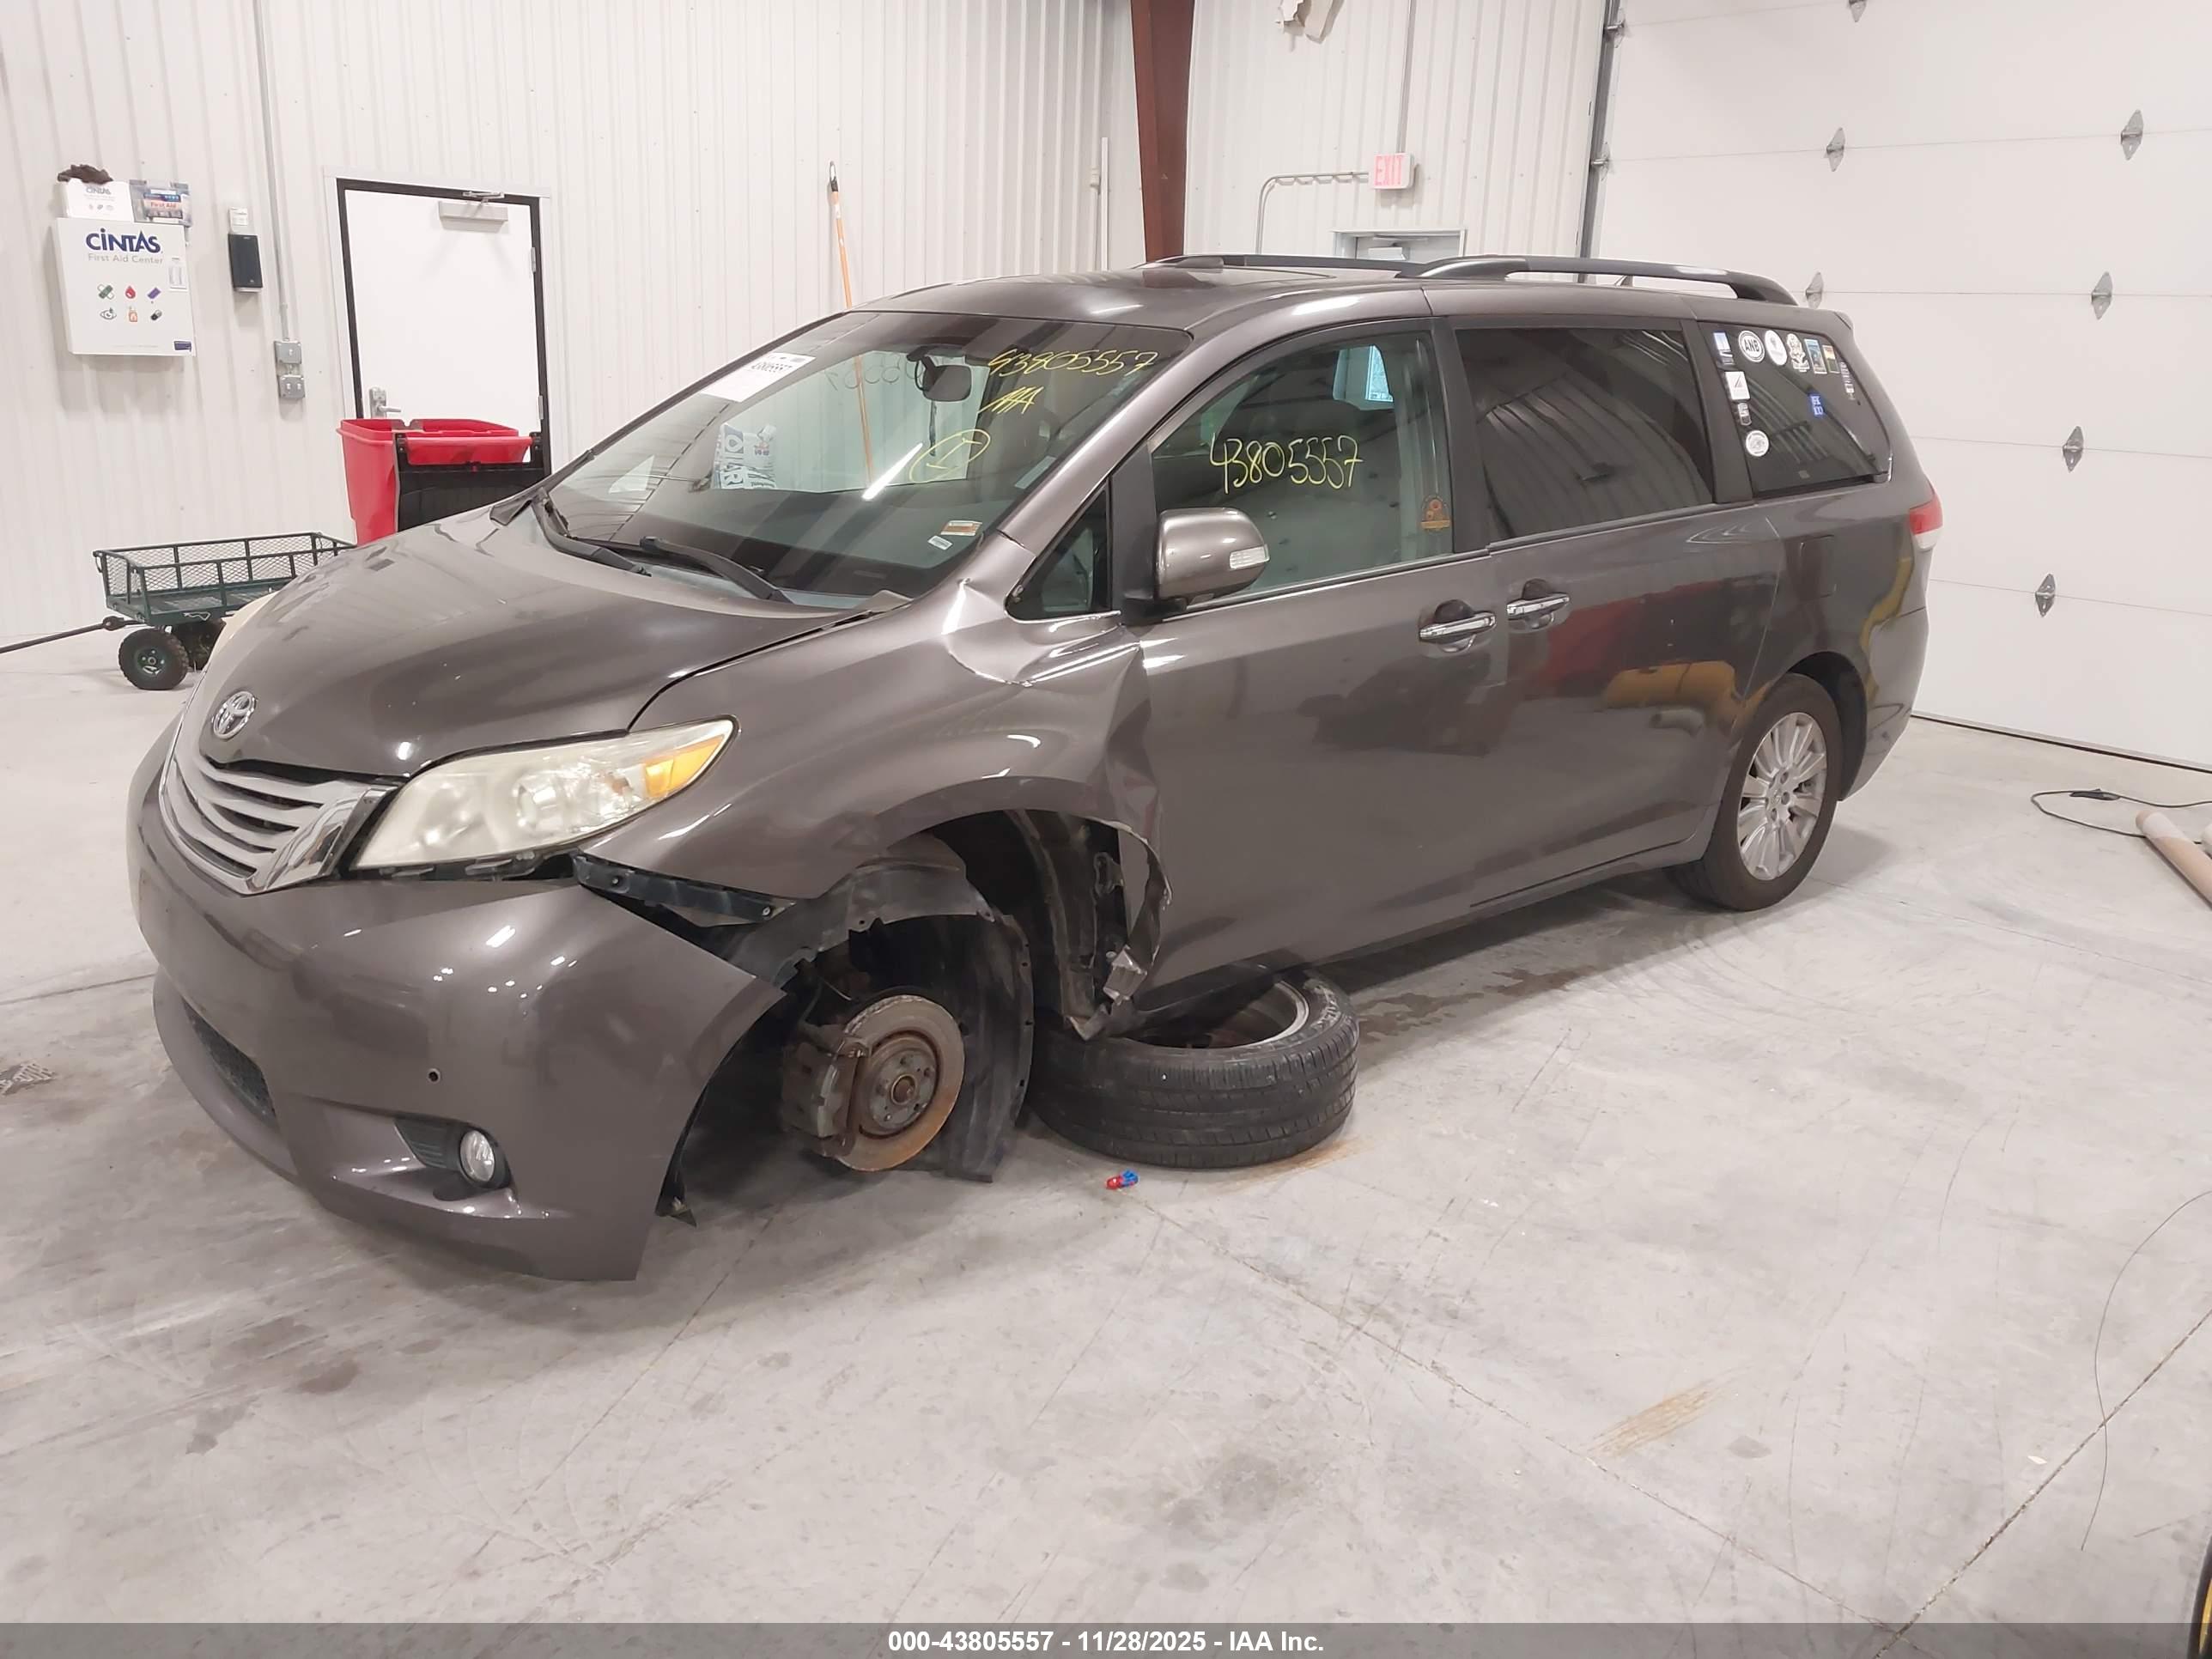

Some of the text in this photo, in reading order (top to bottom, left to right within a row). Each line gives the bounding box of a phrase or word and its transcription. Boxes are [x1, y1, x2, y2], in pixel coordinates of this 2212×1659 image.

[1375, 155, 1401, 186] EXIT
[88, 253, 109, 262] First
[131, 255, 163, 264] Center
[1209, 432, 1364, 495] 43805557
